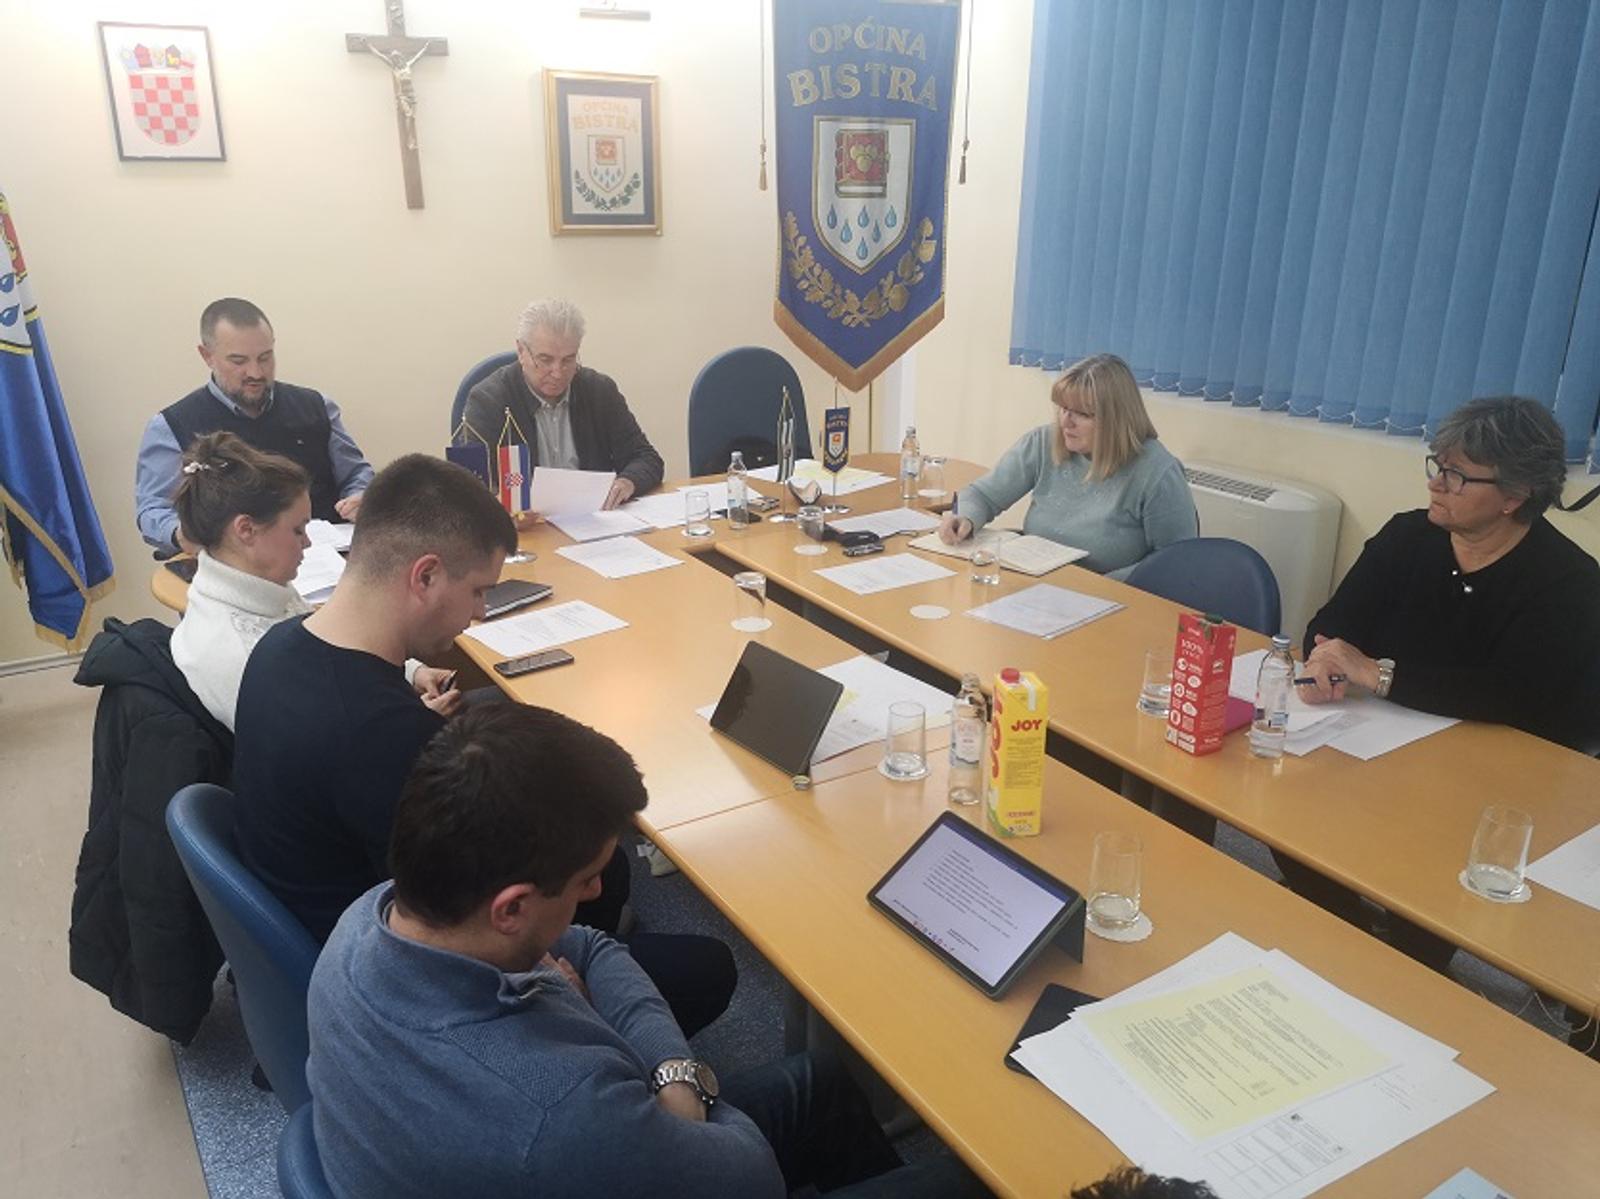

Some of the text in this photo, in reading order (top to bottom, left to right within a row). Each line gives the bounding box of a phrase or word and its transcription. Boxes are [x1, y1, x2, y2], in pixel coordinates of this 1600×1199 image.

[809, 16, 926, 61] OPĆINA
[786, 62, 938, 111] BISTRA
[573, 113, 640, 134] BISTRA
[1011, 719, 1043, 732] JOY
